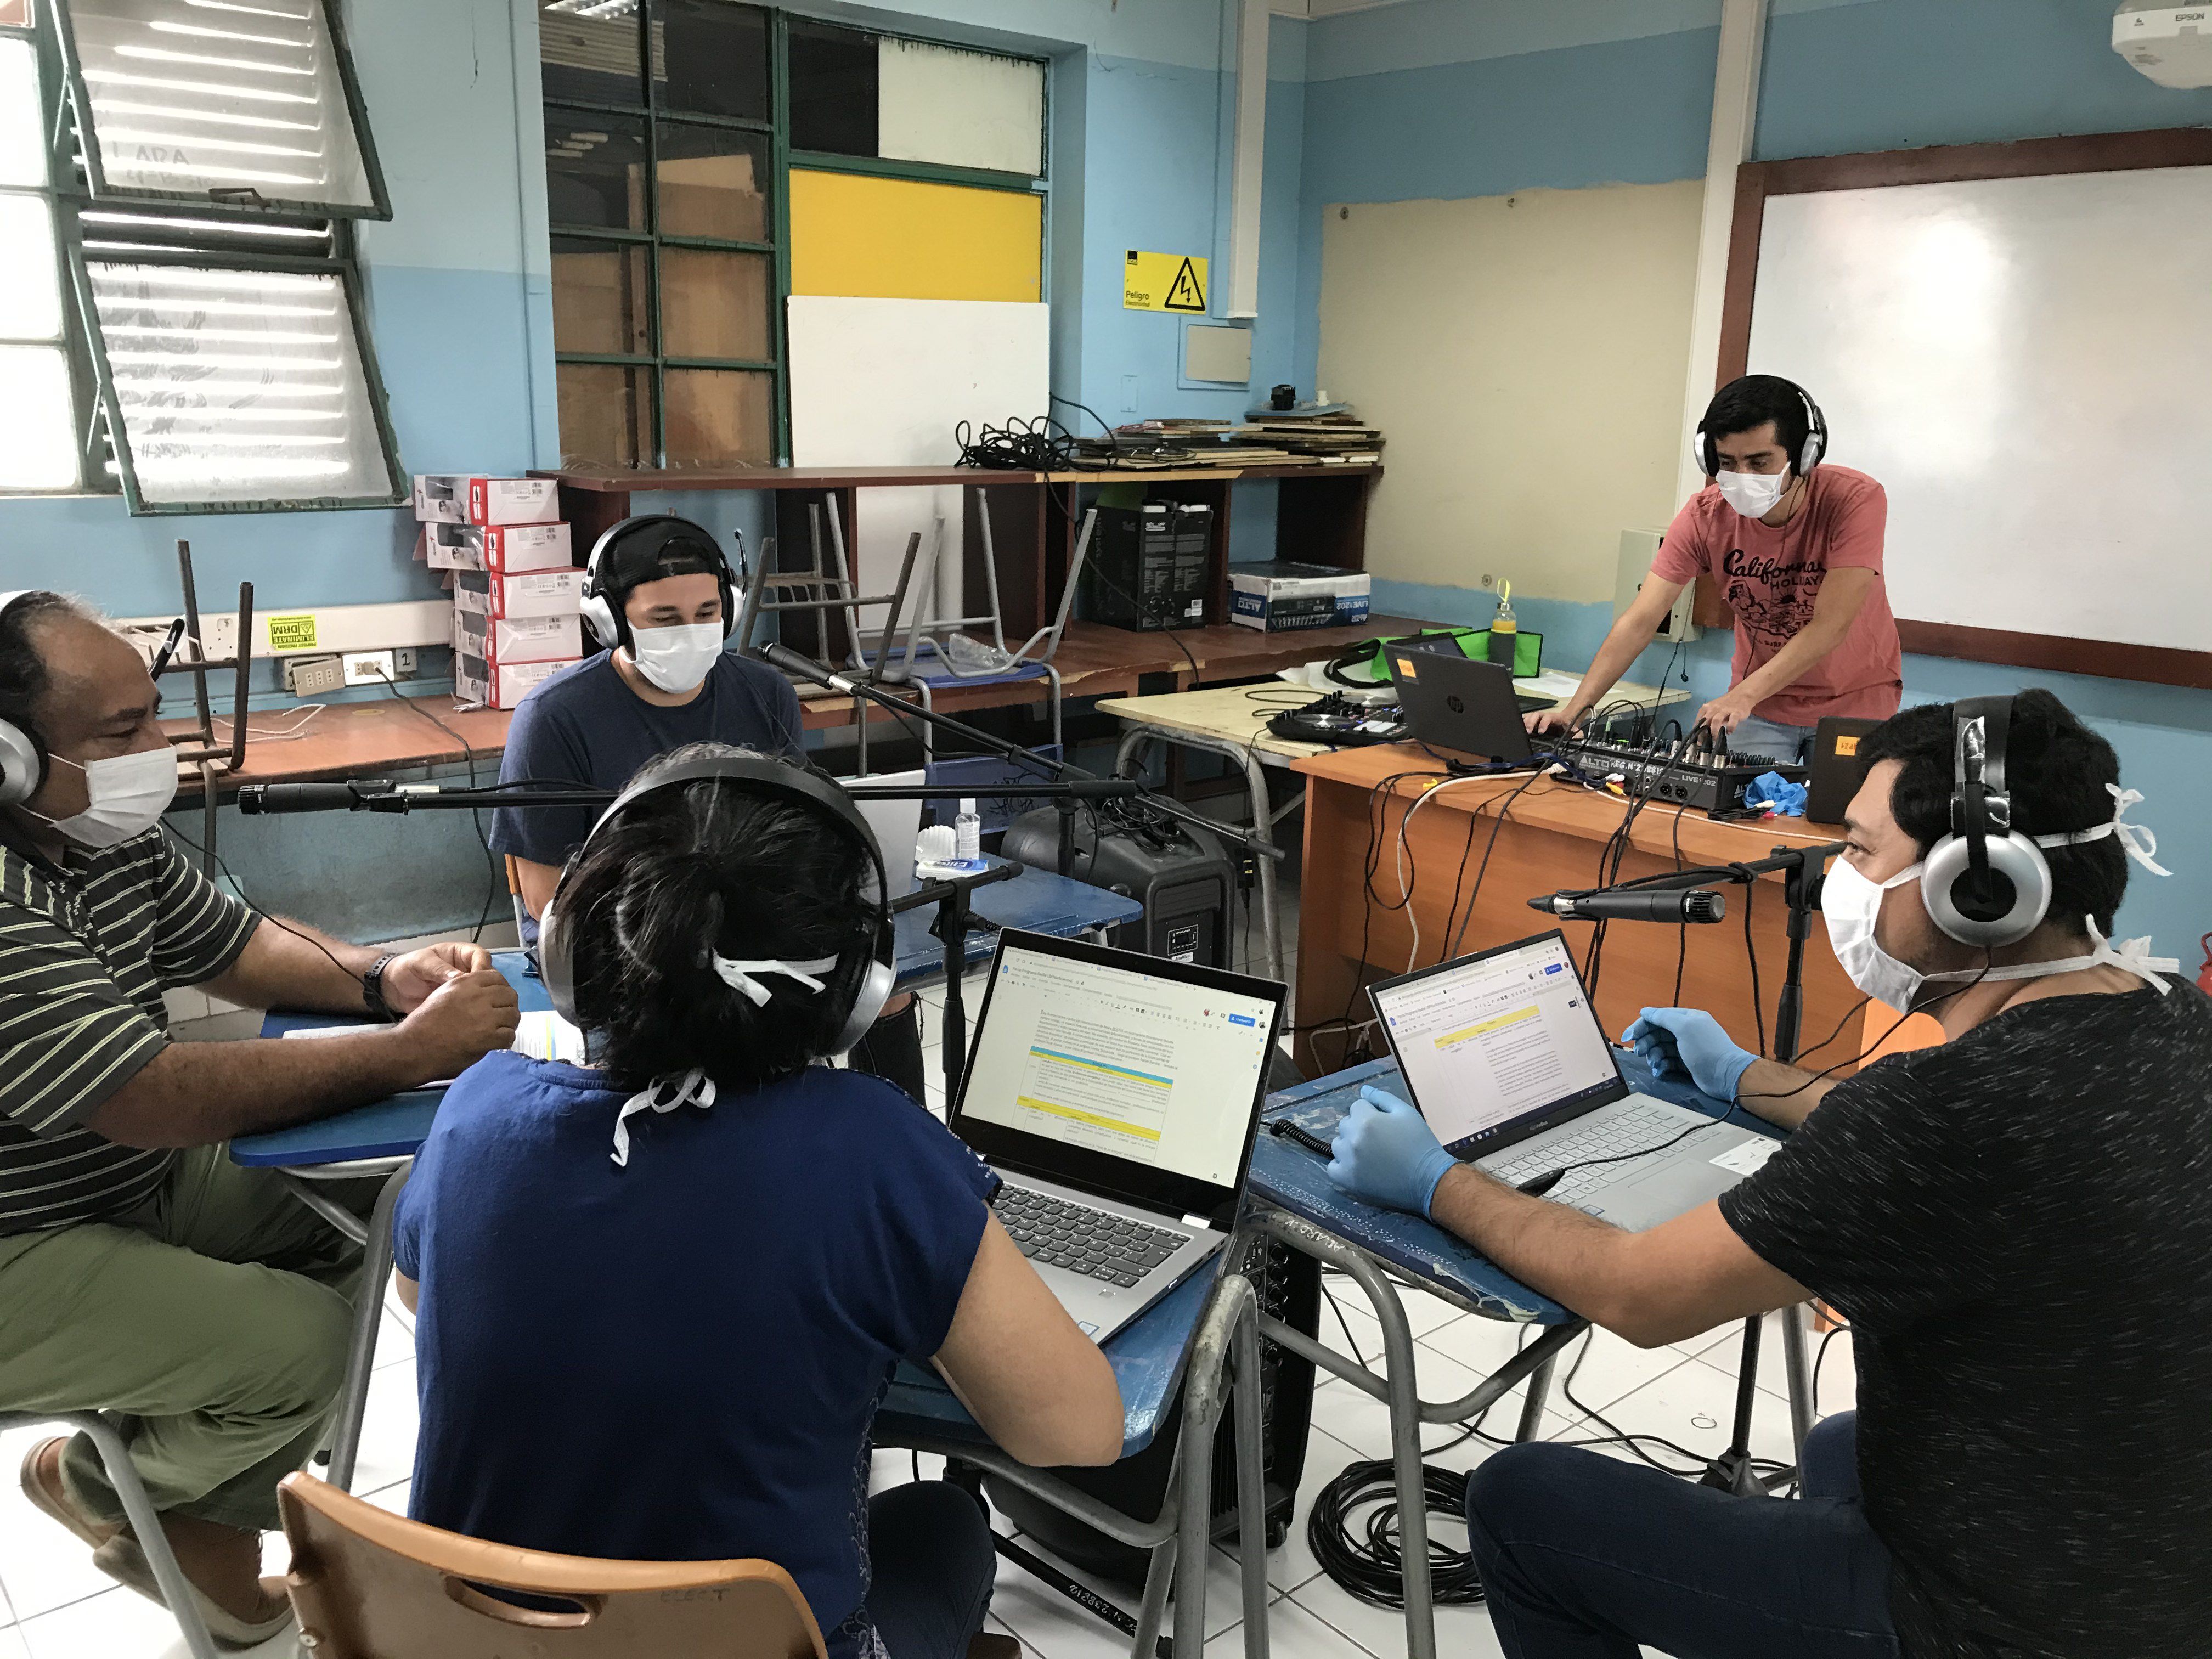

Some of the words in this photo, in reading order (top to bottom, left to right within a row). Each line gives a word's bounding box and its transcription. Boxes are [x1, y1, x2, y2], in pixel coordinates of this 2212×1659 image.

[2175, 12, 2205, 22] EPSON
[1126, 290, 1150, 301] Peligro
[1723, 549, 1827, 585] California
[273, 624, 298, 635] DRM
[274, 635, 314, 644] ELIMINATE
[1579, 755, 1609, 767] ALTO
